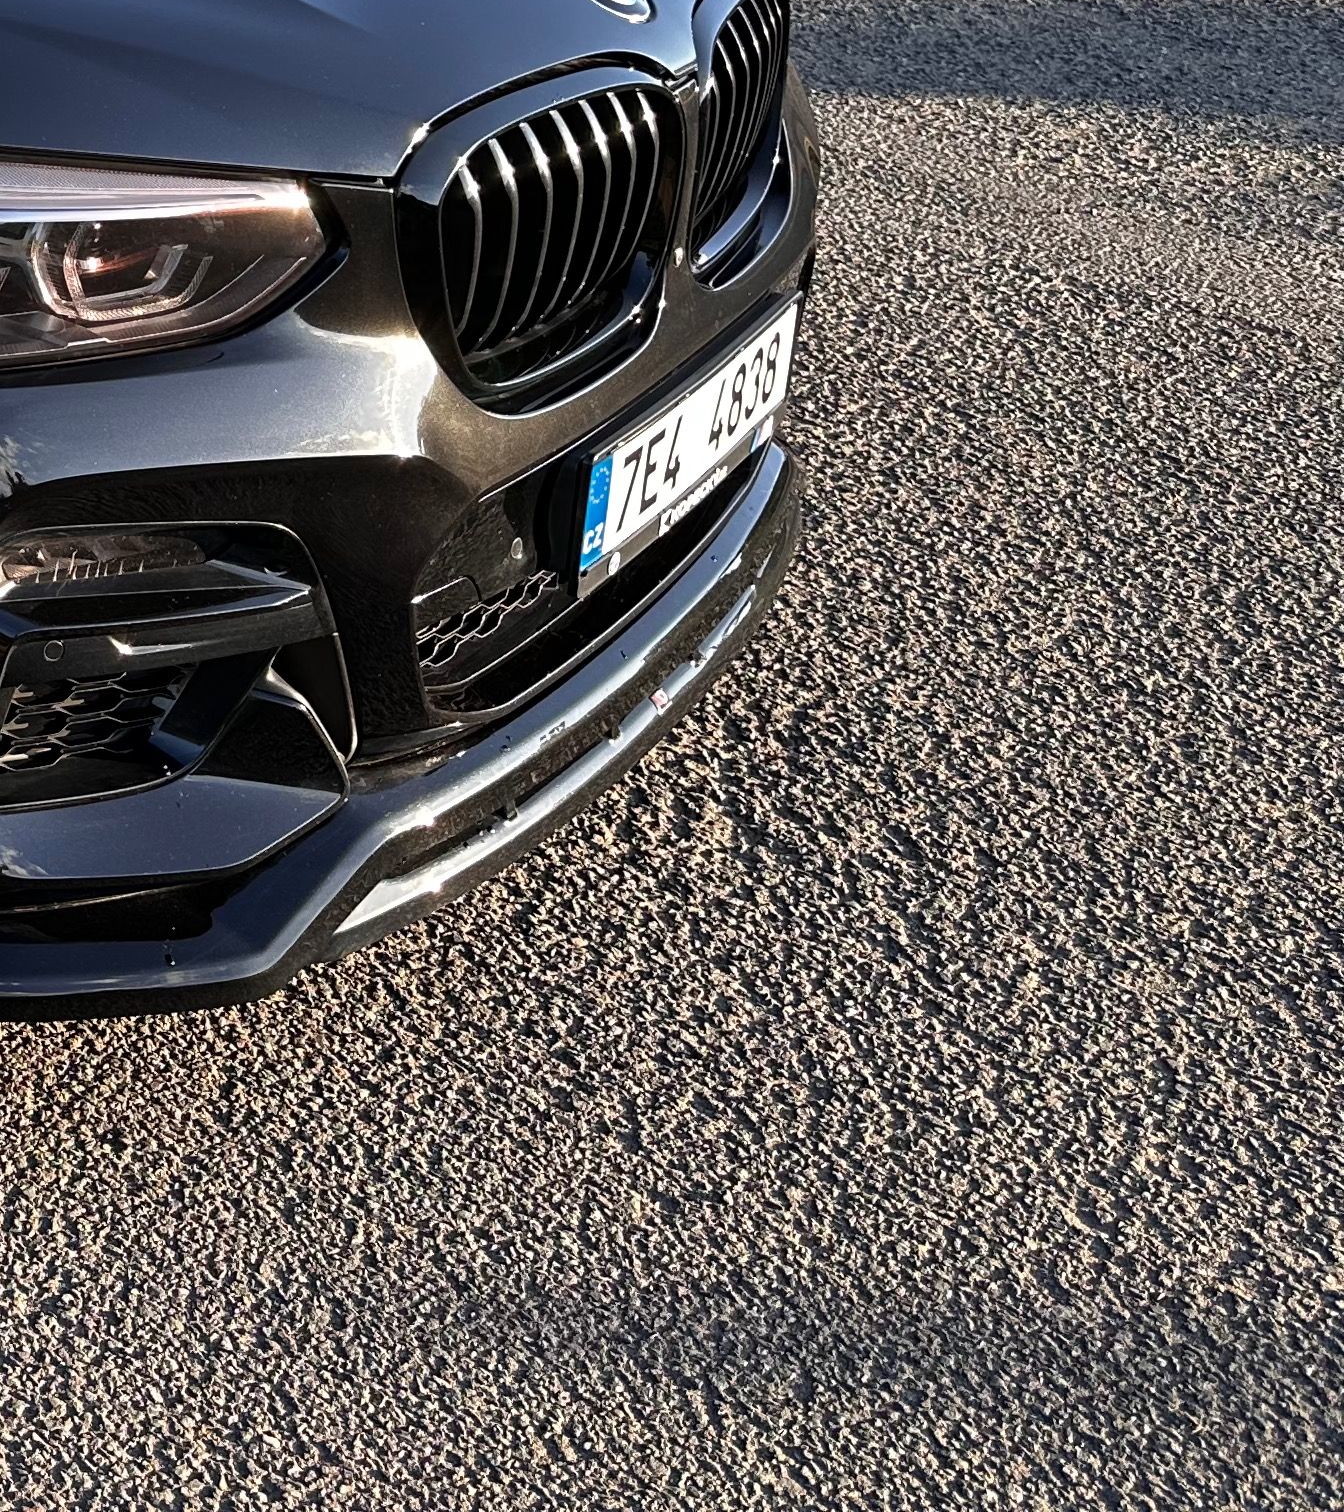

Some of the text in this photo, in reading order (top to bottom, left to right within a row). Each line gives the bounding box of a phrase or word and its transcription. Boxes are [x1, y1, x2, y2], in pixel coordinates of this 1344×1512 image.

[616, 414, 683, 534] 7E4
[708, 332, 780, 451] 4838
[582, 521, 604, 555] CZ
